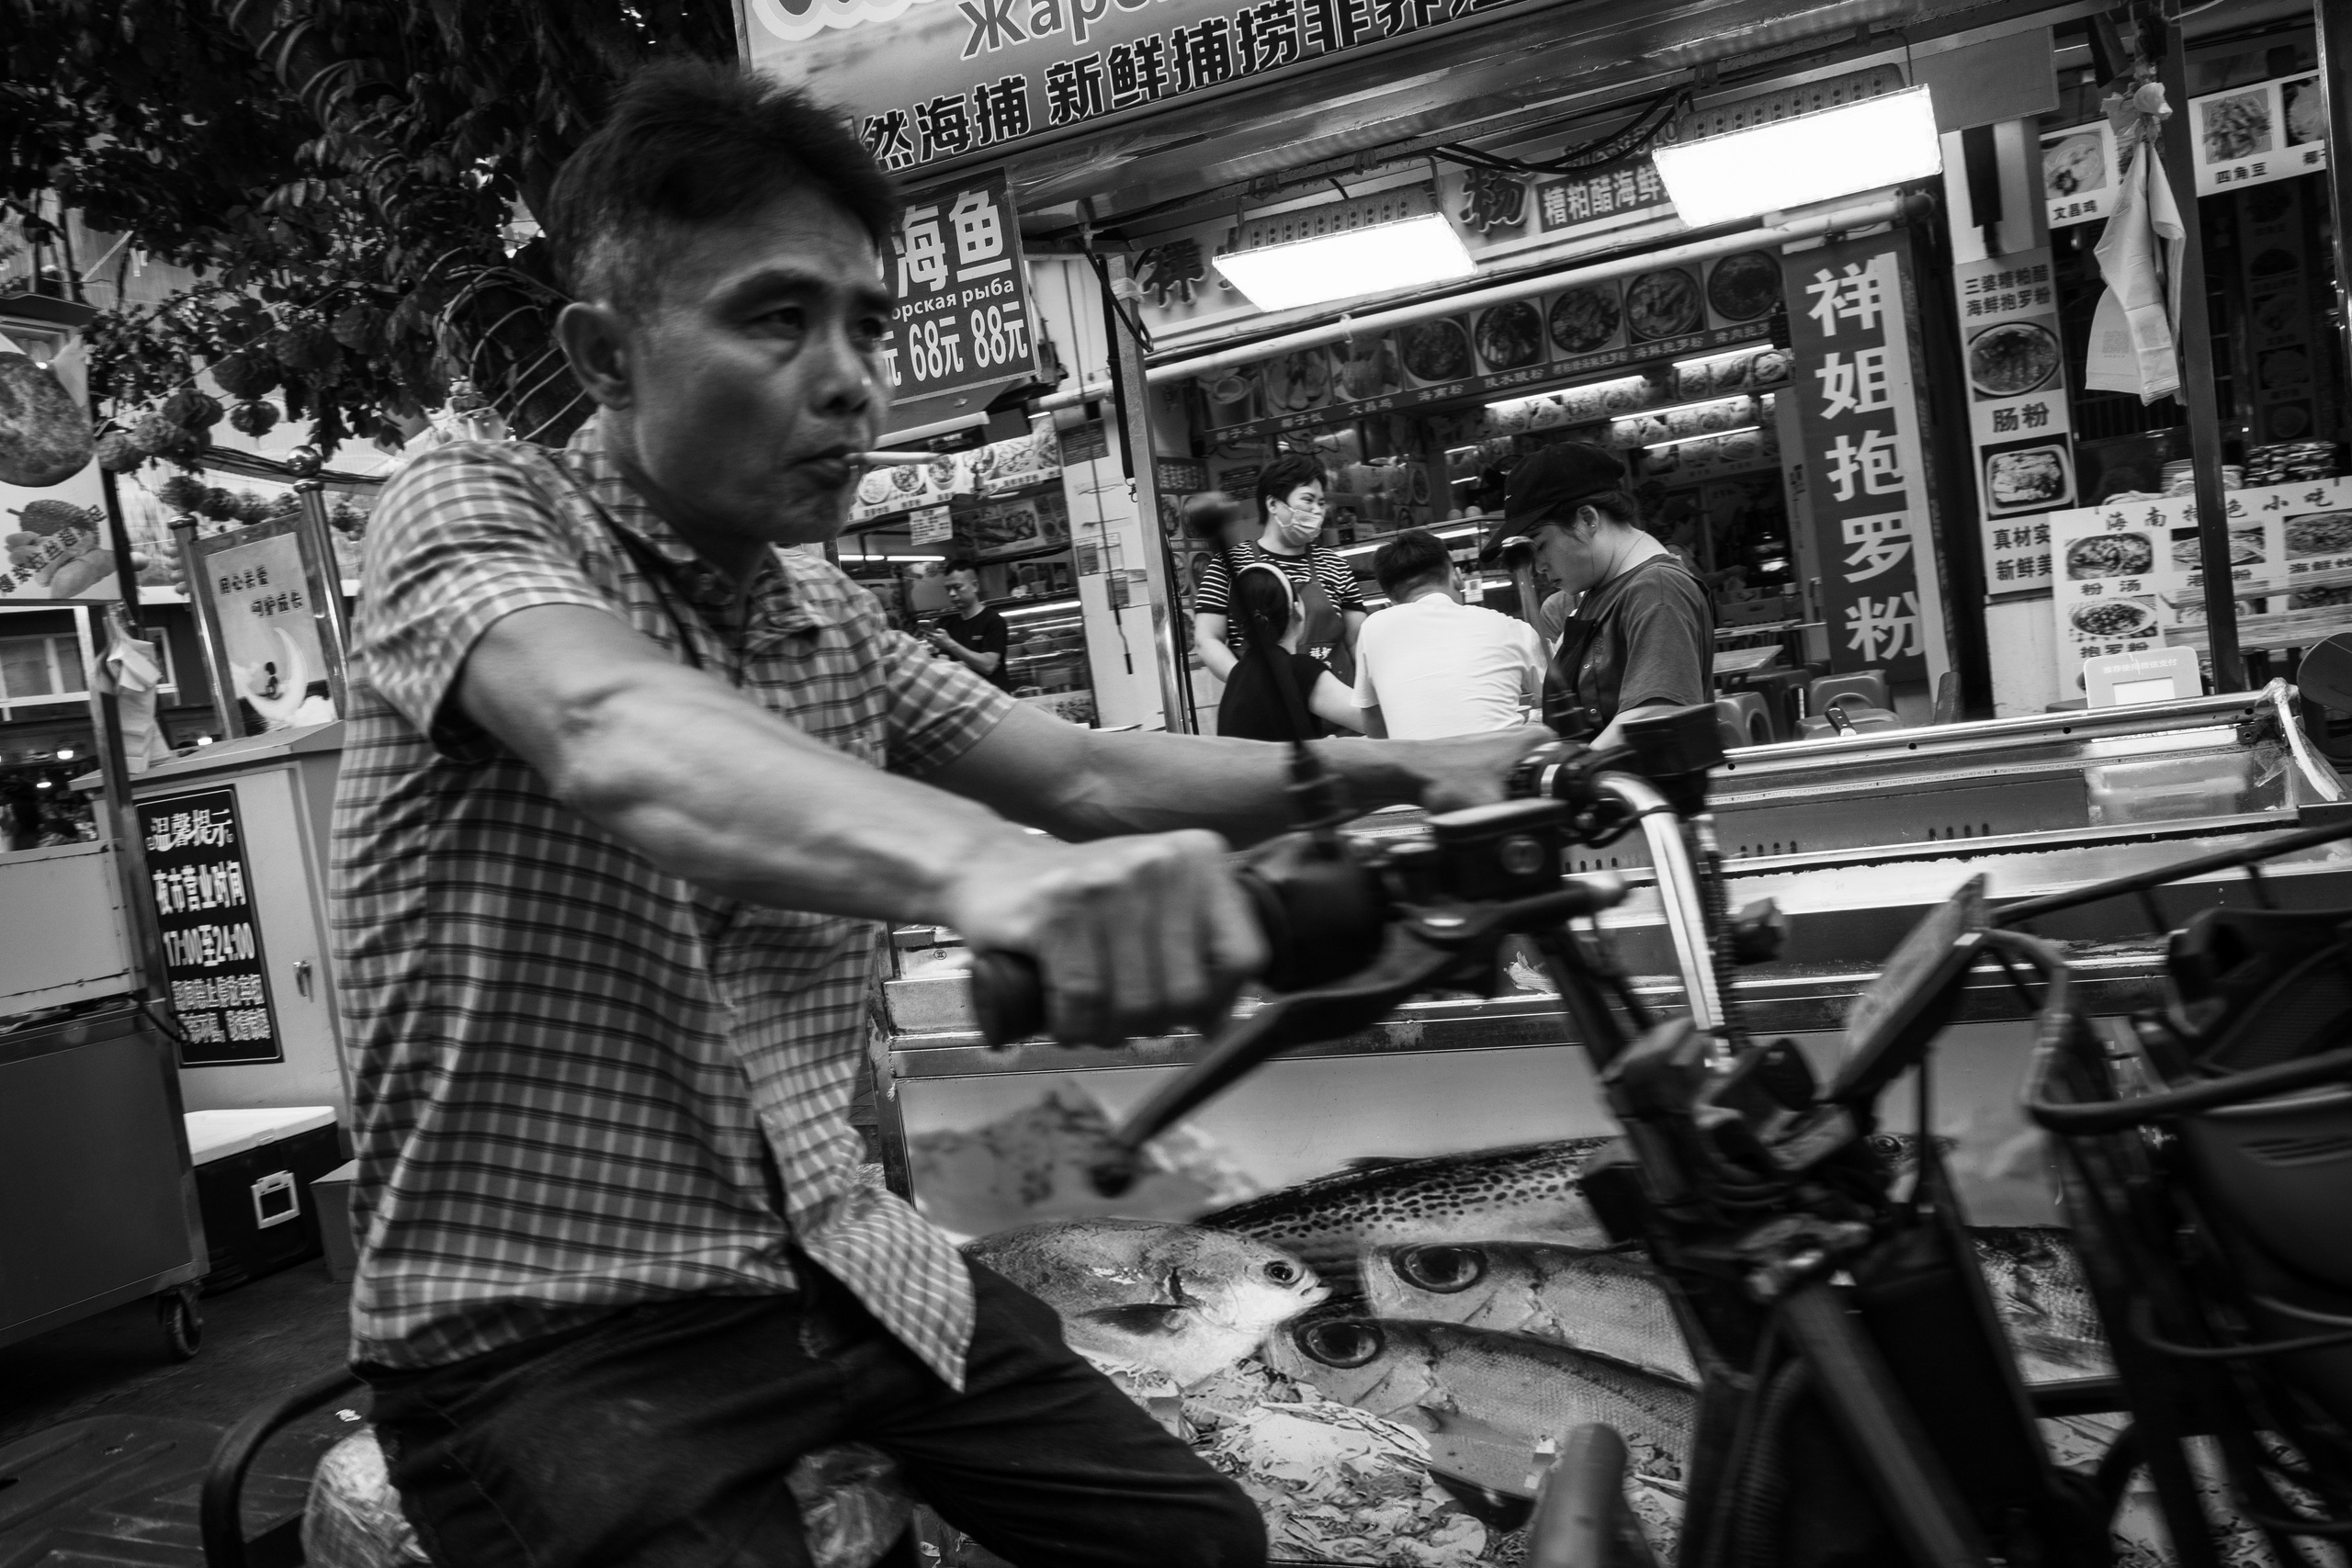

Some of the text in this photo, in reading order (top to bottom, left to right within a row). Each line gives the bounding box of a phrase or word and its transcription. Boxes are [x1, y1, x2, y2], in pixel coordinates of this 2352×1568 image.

[958, 0, 1154, 60] Жар
[840, 75, 1030, 173] 然海捕
[1543, 163, 1671, 226] 糟粕醋海鲜
[2215, 162, 2269, 185] 四角豆
[2053, 198, 2098, 220] 文昌鸡
[962, 277, 1014, 308] рыба
[1966, 286, 2052, 317] 海鲜抱罗粉
[909, 315, 964, 381] 68元
[970, 300, 1028, 368] 88元
[1992, 401, 2050, 433] 肠粉
[1805, 256, 1926, 663] 祥姐抱罗粉
[151, 807, 233, 852] 温馨提示
[153, 860, 246, 915] 夜市营业时间
